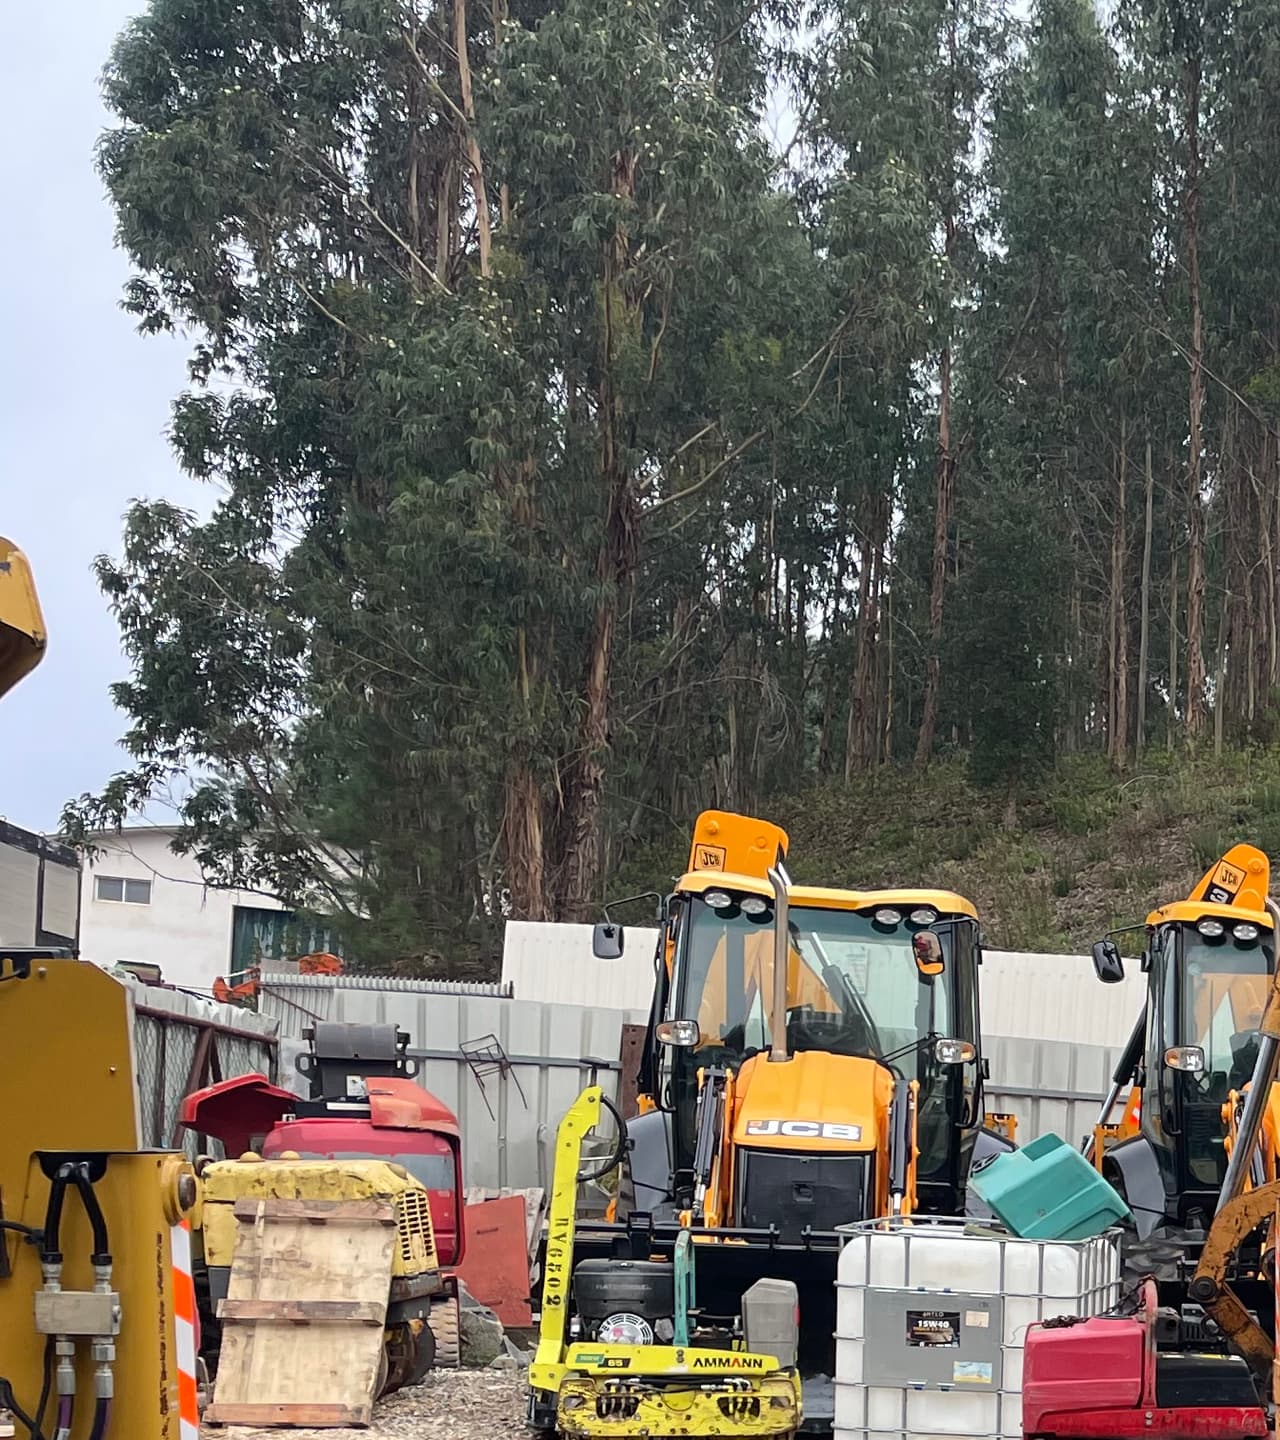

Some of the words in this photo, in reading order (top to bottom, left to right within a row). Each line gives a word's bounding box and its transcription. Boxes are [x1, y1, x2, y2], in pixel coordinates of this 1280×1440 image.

[703, 852, 720, 866] JCB
[748, 1120, 860, 1140] JCB
[693, 1357, 763, 1369] AMMANN
